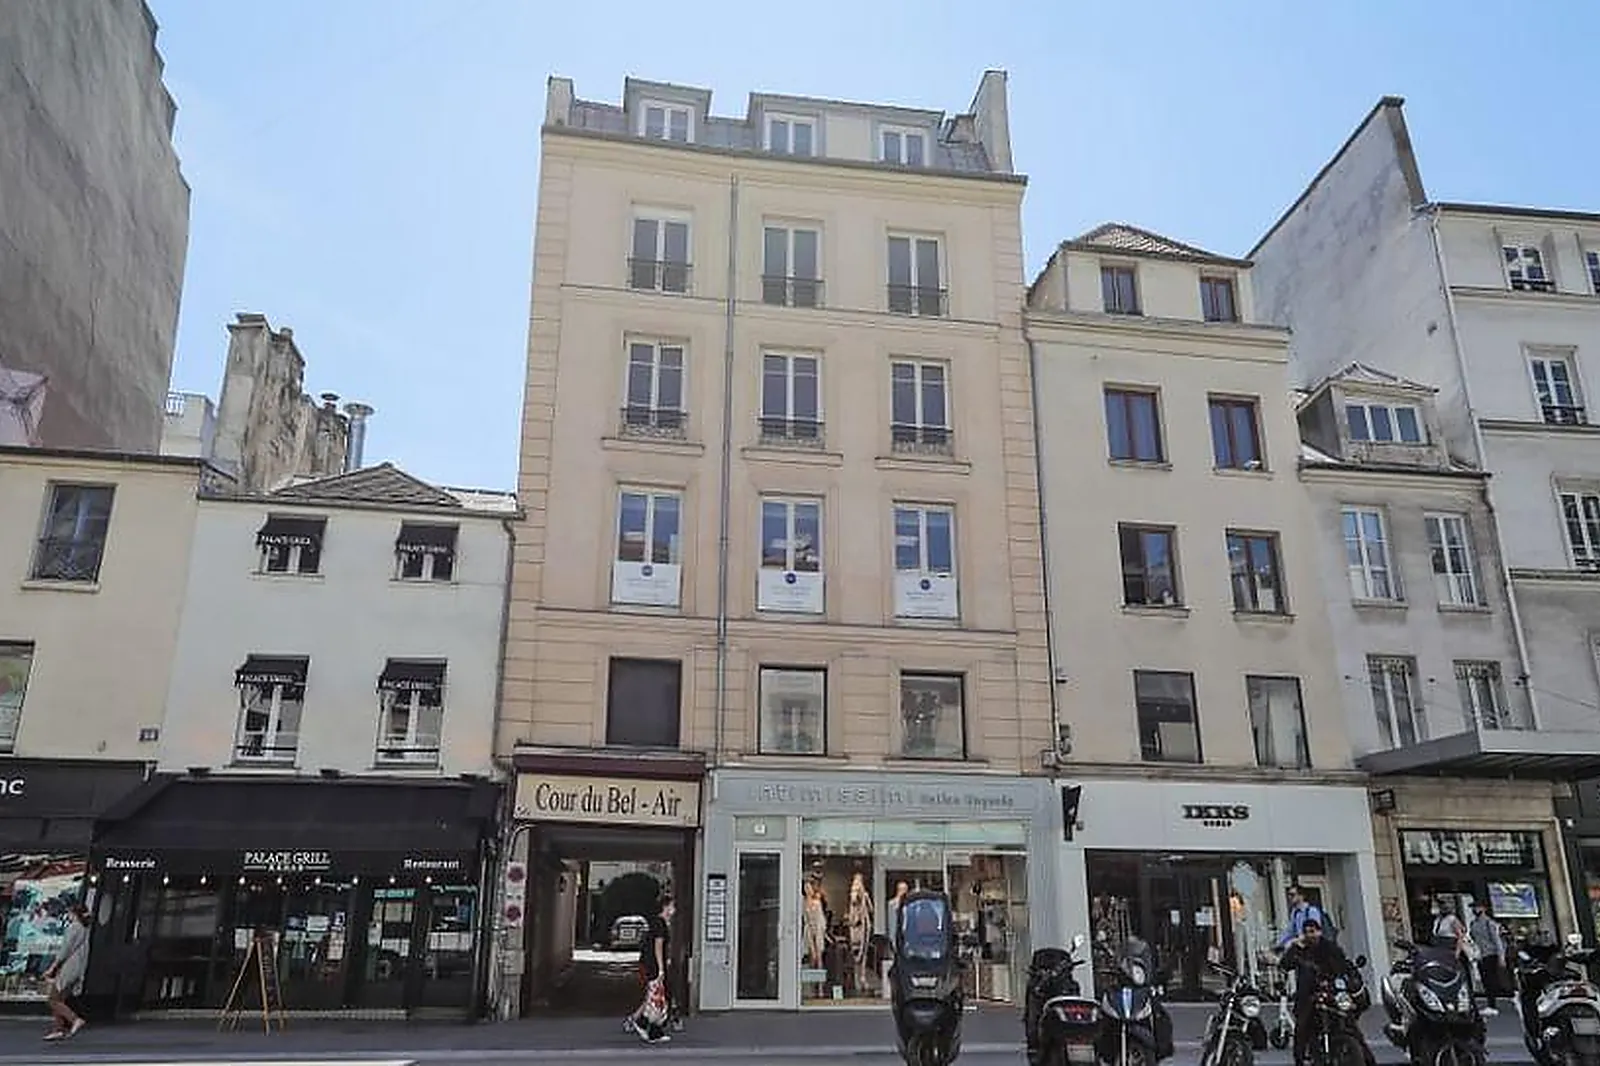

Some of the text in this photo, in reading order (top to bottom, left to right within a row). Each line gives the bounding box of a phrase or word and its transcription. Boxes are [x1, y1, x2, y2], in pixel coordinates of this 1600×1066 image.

[535, 782, 578, 811] Cour
[580, 784, 602, 813] du
[607, 787, 636, 815] Bel
[652, 788, 683, 817] Air
[244, 851, 331, 865] PALACE GRILL
[1404, 839, 1480, 865] LUSH
[106, 857, 156, 869] Brasserie
[404, 859, 460, 869] Restaurant
